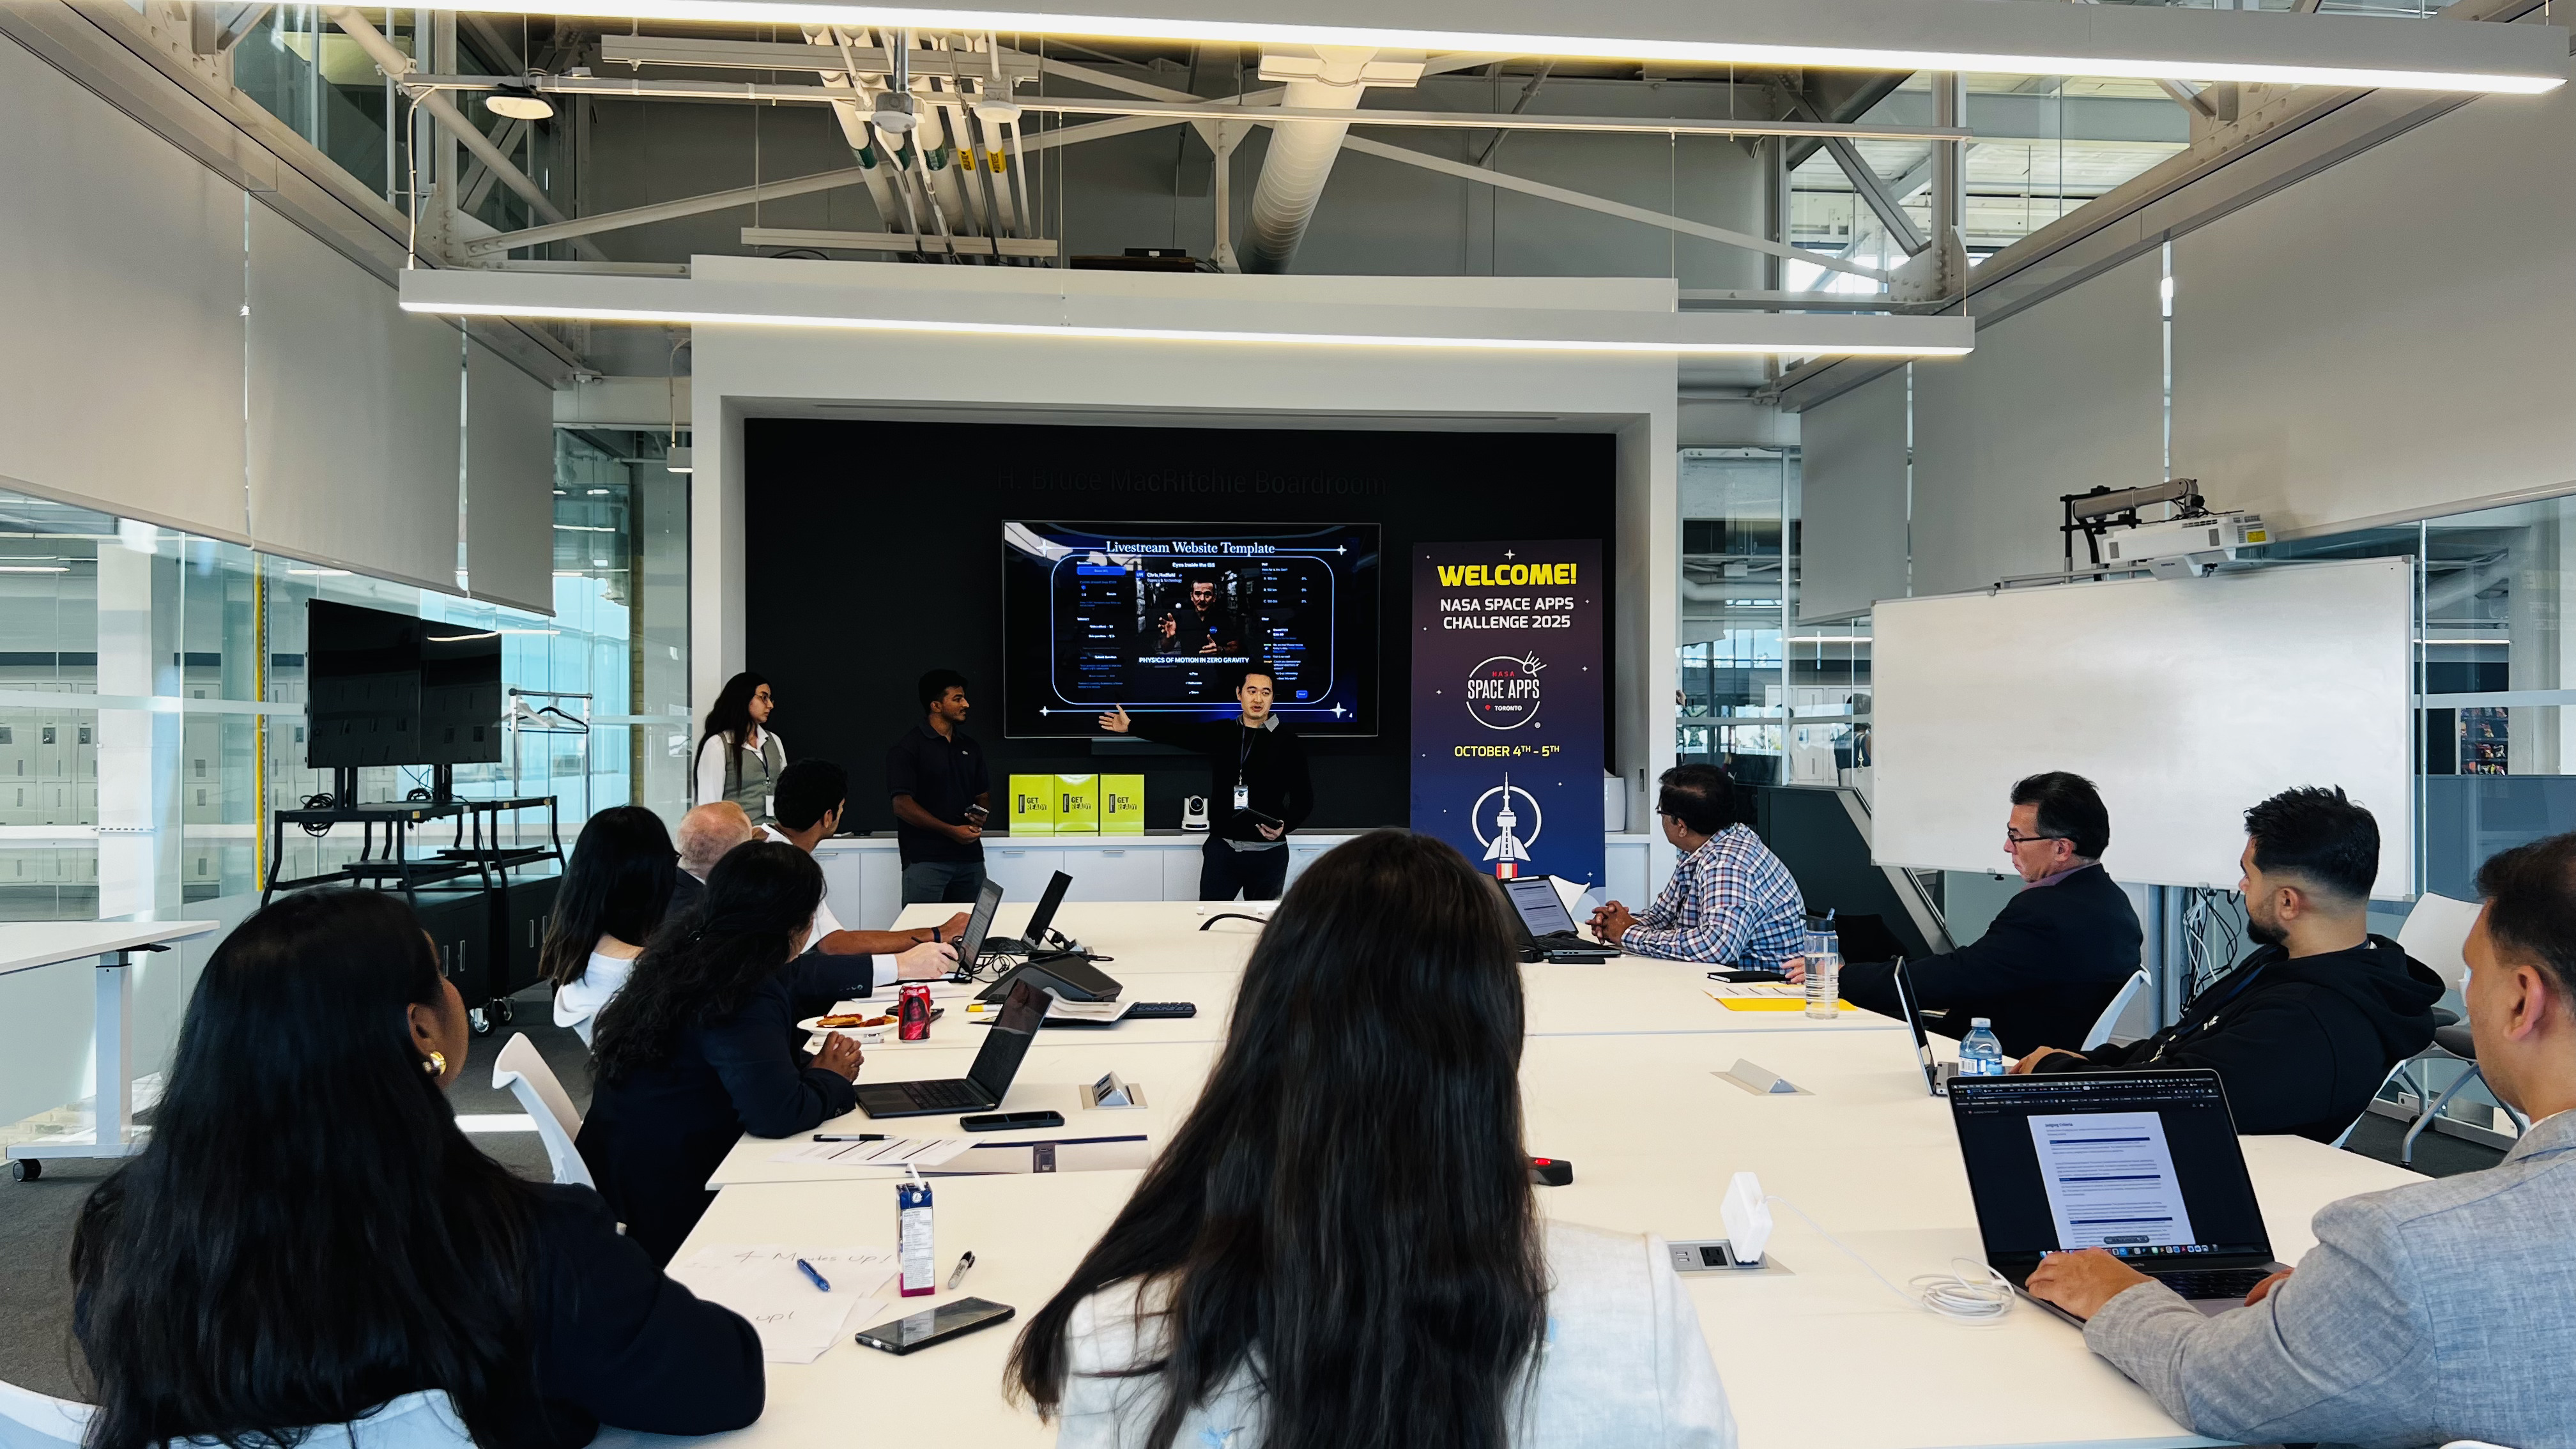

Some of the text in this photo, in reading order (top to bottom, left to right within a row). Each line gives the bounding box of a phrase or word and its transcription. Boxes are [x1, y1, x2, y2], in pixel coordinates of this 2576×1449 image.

[1031, 469, 1103, 491] Bruce
[1110, 468, 1246, 493] MacRitchie
[1255, 470, 1388, 495] Boardroom
[1106, 541, 1275, 557] Livestream Website Template
[1438, 563, 1577, 586] WELCOME!
[1440, 597, 1574, 611] NASA SPACE APPS
[1443, 615, 1570, 629] CHALLENGE 2025
[1468, 678, 1540, 699] SPACE APPS
[1454, 746, 1510, 757] OCTOBER
[1512, 745, 1531, 757] 4TH
[1542, 745, 1560, 757] 5TH
